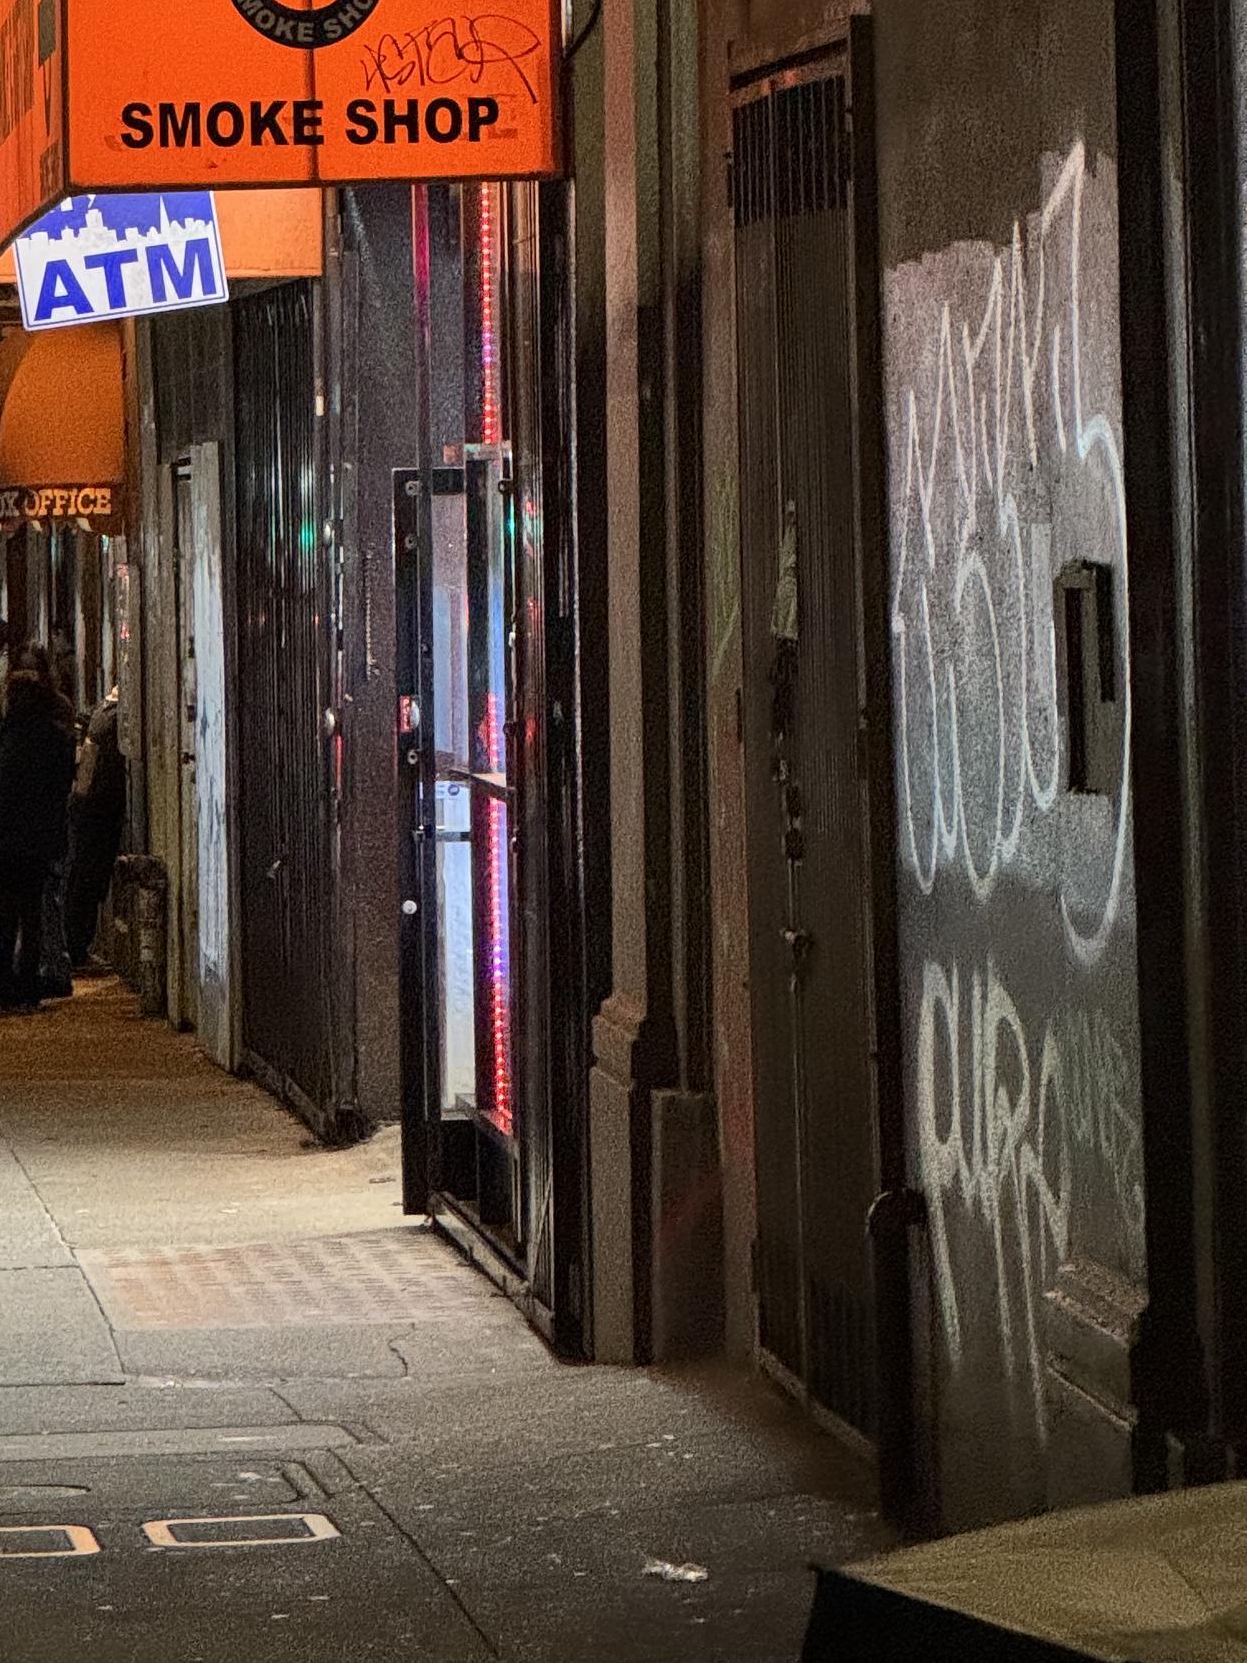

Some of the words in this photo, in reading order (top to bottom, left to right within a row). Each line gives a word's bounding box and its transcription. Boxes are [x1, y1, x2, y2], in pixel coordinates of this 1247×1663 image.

[121, 100, 324, 149] SMOKE
[345, 97, 500, 145] SHOP
[34, 238, 216, 321] ATM
[25, 488, 112, 516] OFFICE
